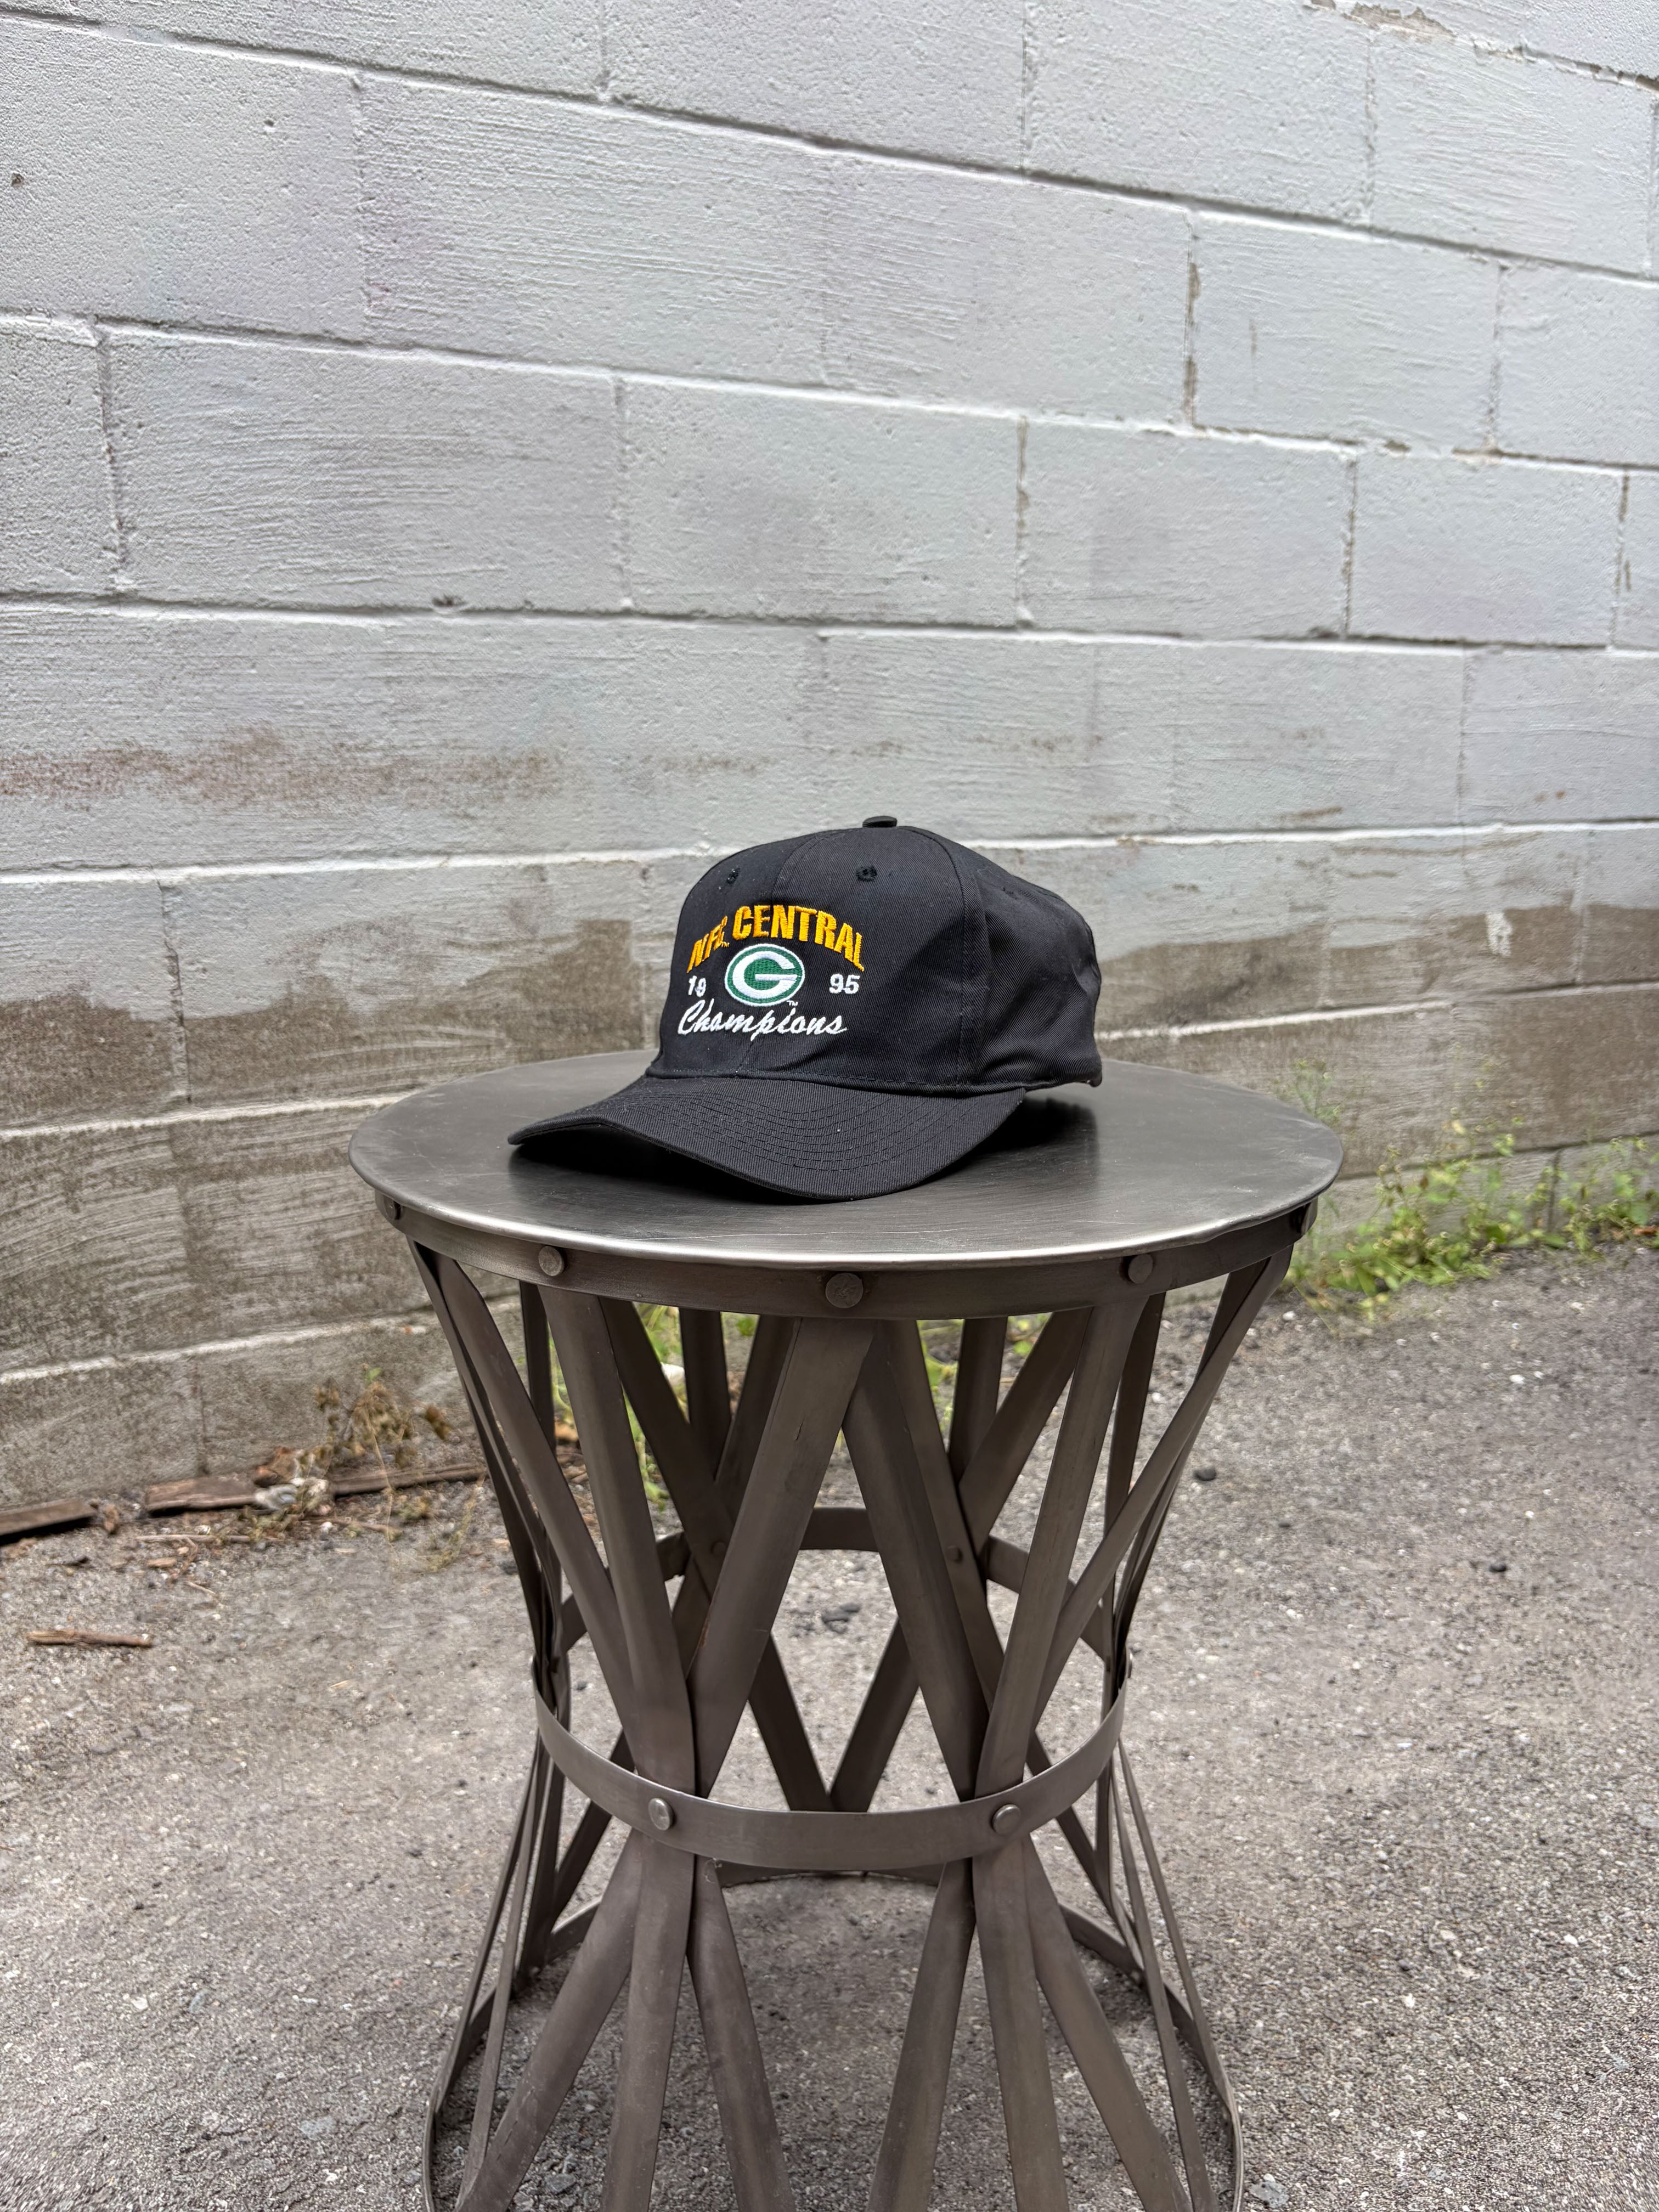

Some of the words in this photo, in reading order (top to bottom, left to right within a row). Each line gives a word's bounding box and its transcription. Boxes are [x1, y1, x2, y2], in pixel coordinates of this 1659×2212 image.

[732, 905, 864, 972] CENTRAL
[688, 975, 707, 997] 19
[829, 974, 860, 994] 95
[678, 998, 848, 1041] Champions
